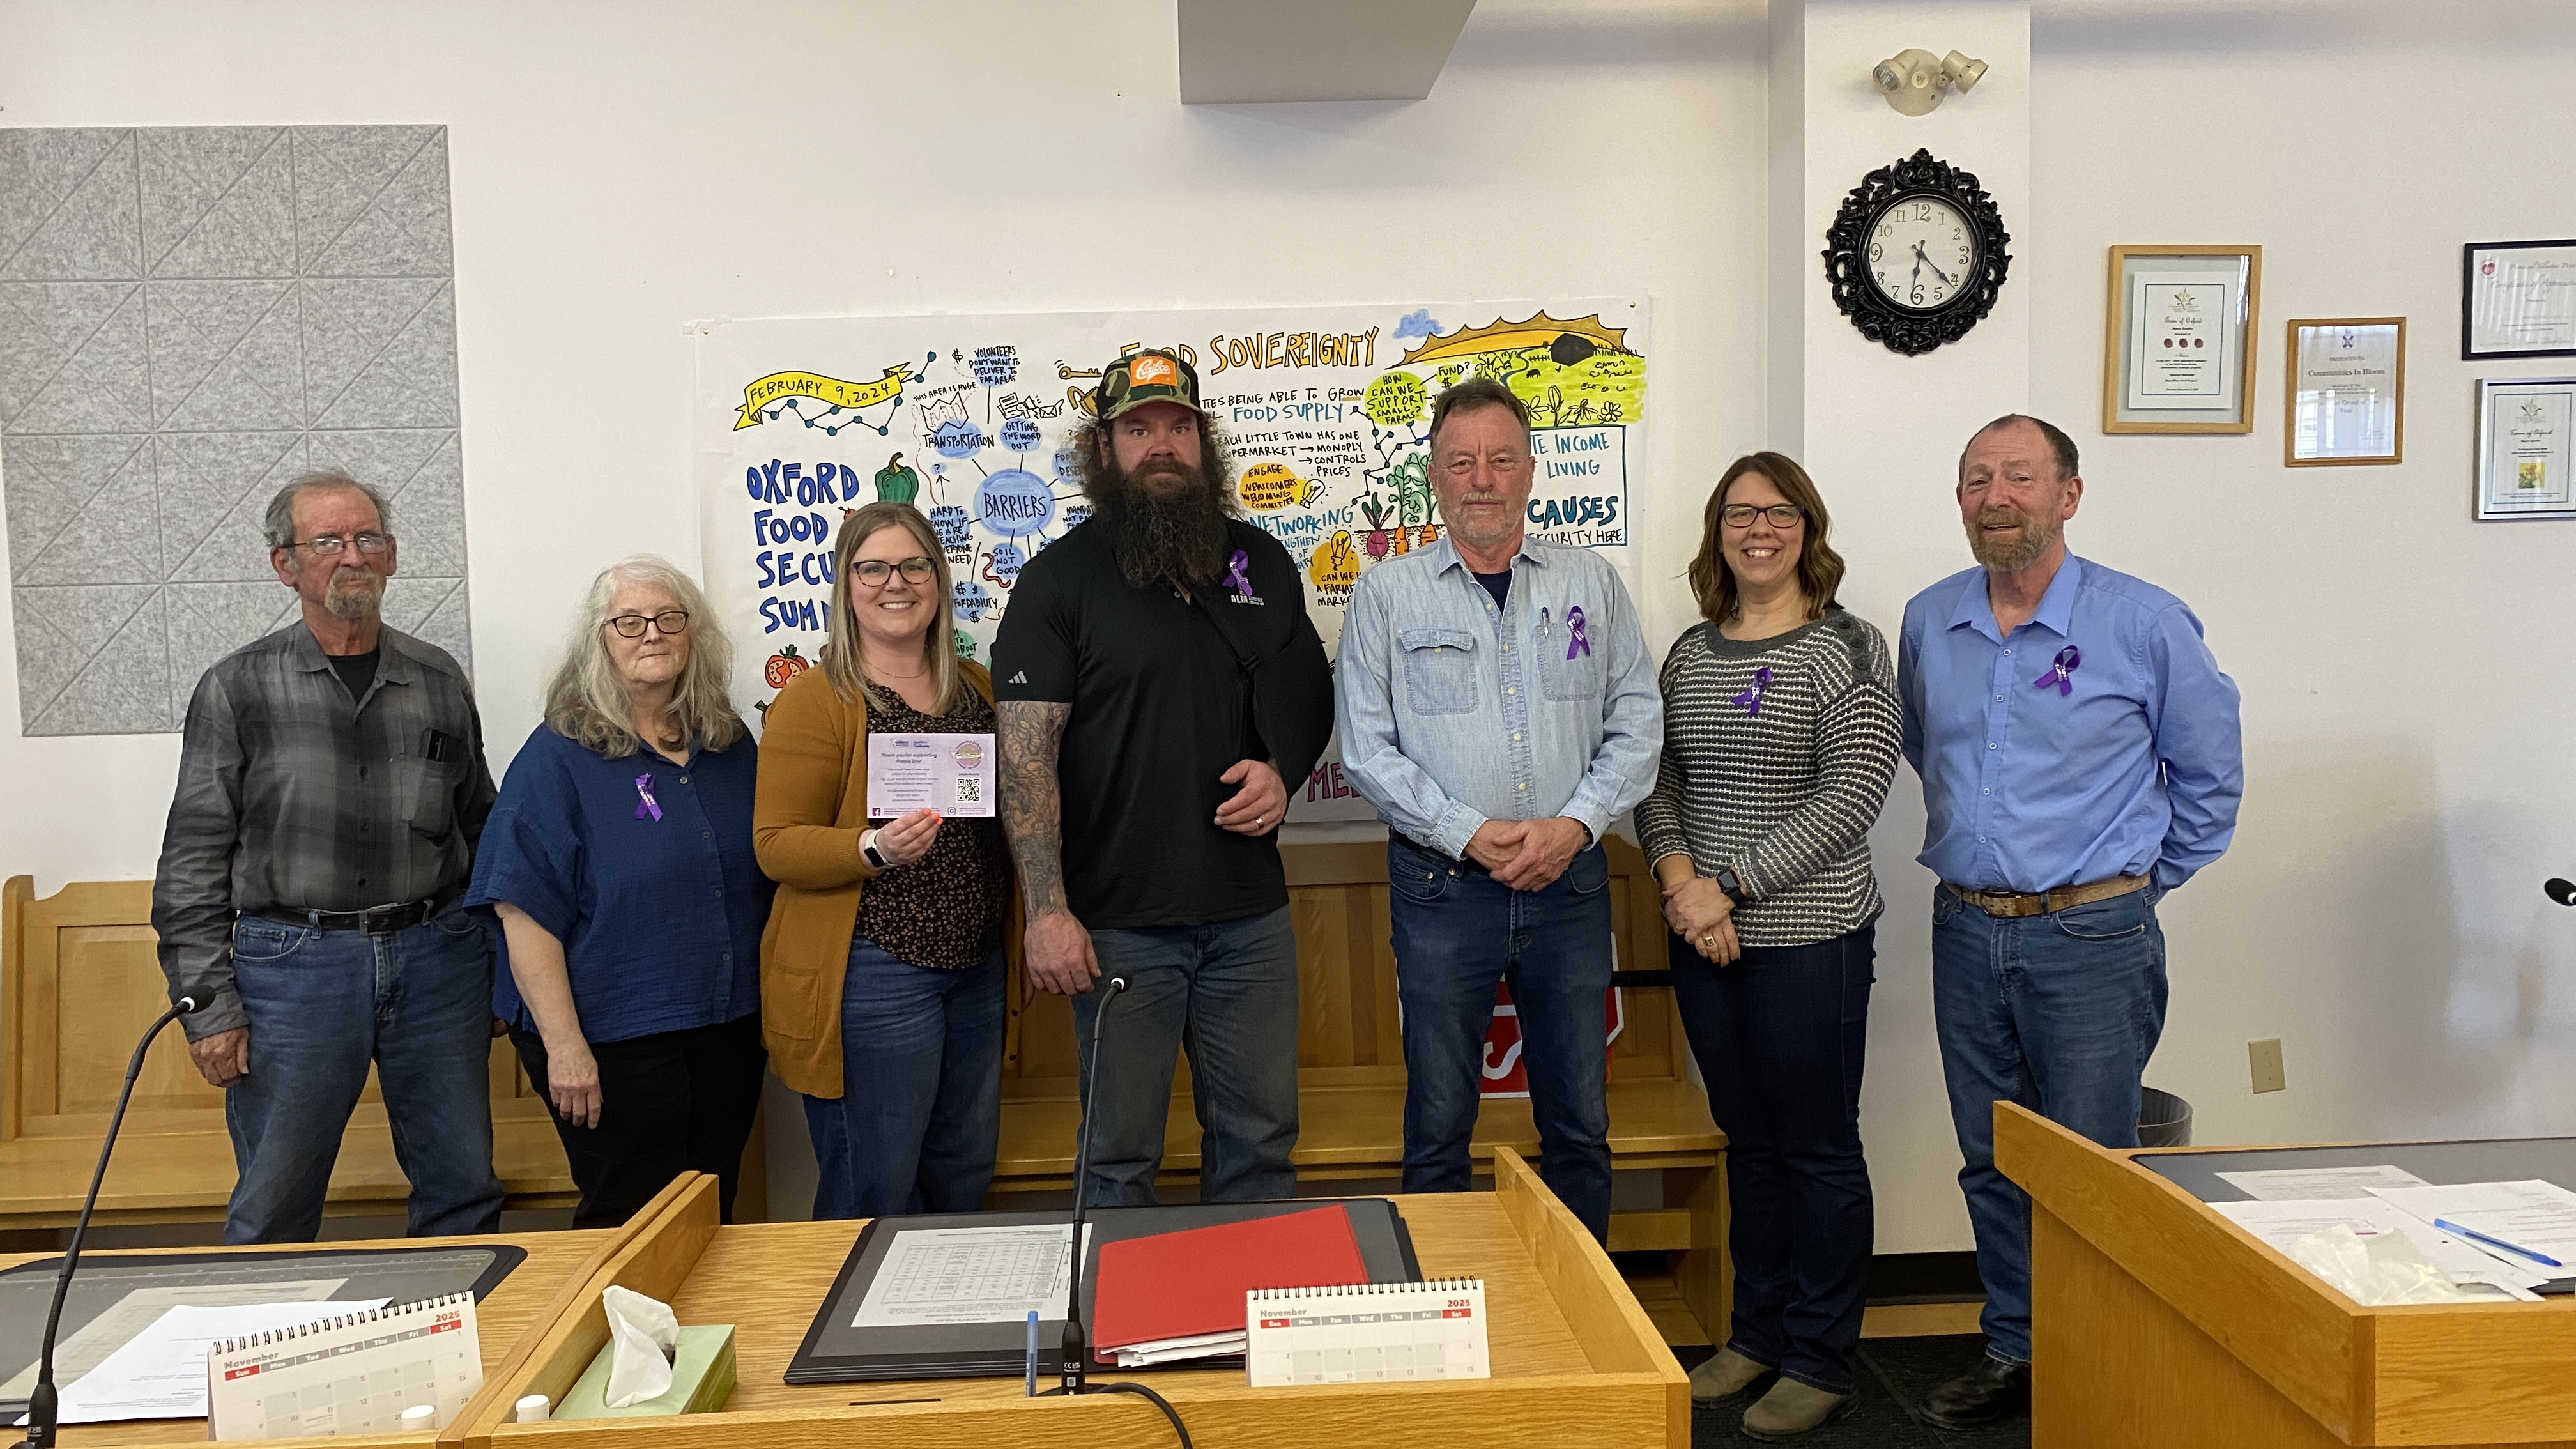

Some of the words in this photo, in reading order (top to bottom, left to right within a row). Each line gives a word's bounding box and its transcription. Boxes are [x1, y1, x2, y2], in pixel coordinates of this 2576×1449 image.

[1894, 210, 1906, 222] 11
[1912, 203, 1931, 221] 12
[1938, 211, 1945, 225] 1
[1878, 224, 1893, 237] 10
[1953, 227, 1961, 240] 2
[1869, 243, 1883, 263] 9
[1959, 245, 1969, 264] 3
[1877, 271, 1885, 285] 8
[1951, 273, 1959, 287] 4
[1892, 286, 1901, 299] 7
[1910, 284, 1924, 305] 6
[1934, 287, 1942, 300] 5
[974, 346, 1016, 358] VOLUNTEERS
[1211, 326, 1380, 376] SOVEREIGNTY
[990, 358, 1011, 366] WANT
[974, 367, 1006, 376] DELIVER
[1438, 361, 1470, 377] FUND?
[979, 376, 993, 384] FAR
[994, 374, 1016, 385] AREAS
[1383, 374, 1402, 385] HOW
[749, 379, 822, 407] FEBRUARY
[852, 383, 889, 403] 2024
[913, 393, 928, 402] THIS
[928, 387, 947, 399] AREA
[958, 381, 976, 391] HUGE
[1372, 387, 1393, 397] CAN
[1397, 382, 1414, 395] WE
[1228, 394, 1264, 406] BEING
[1269, 389, 1298, 403] ABLE
[1305, 388, 1317, 400] TO
[1328, 388, 1365, 402] GROW
[1367, 390, 1425, 410] SUPPORT
[1234, 406, 1278, 422] FOOD
[1282, 402, 1344, 423] SUPPLY
[1376, 406, 1411, 417] SMALL
[1006, 420, 1039, 432] GETTING
[922, 433, 995, 450] TRANSPORTATION
[1002, 432, 1019, 440] THE
[1020, 432, 1041, 441] WORD
[1246, 431, 1279, 443] LITTLE
[1283, 431, 1312, 440] TOWN
[1317, 431, 1336, 440] HAS
[1339, 431, 1360, 440] ONE
[1554, 432, 1610, 454] INCOME
[1011, 441, 1031, 450] OUT
[1220, 445, 1298, 458] SUPERMARKET
[1314, 454, 1366, 464] CONTROLS
[1248, 464, 1284, 478] ENGAGE
[1317, 466, 1351, 477] PRICES
[1546, 459, 1600, 479] LIVING
[746, 459, 859, 507] OXFORD
[1245, 479, 1298, 493] NEWCOMERS
[984, 492, 1048, 521] BARRIERS
[1251, 496, 1294, 509] COMMITTEE
[930, 506, 953, 518] HARD
[954, 506, 963, 516] TO
[1527, 496, 1618, 530] CAUSES
[754, 509, 829, 546] FOOD
[931, 519, 954, 528] NOW
[958, 517, 967, 526] IF
[1246, 506, 1353, 536] NETWORKING
[939, 532, 973, 544] EACHING
[1596, 528, 1623, 543] HERE
[993, 548, 1015, 556] SOIL
[948, 554, 972, 565] NEED
[756, 550, 834, 589] SECU
[996, 565, 1020, 574] GOOD
[1321, 572, 1338, 581] CAN
[1340, 572, 1354, 581] WE
[1323, 584, 1355, 595] FARME
[435, 1310, 461, 1323] 2025
[1260, 1308, 1307, 1317] November
[224, 1351, 279, 1370] November
[234, 1369, 250, 1377] Sun
[270, 1361, 286, 1369] Mon
[339, 1345, 355, 1353] Wed
